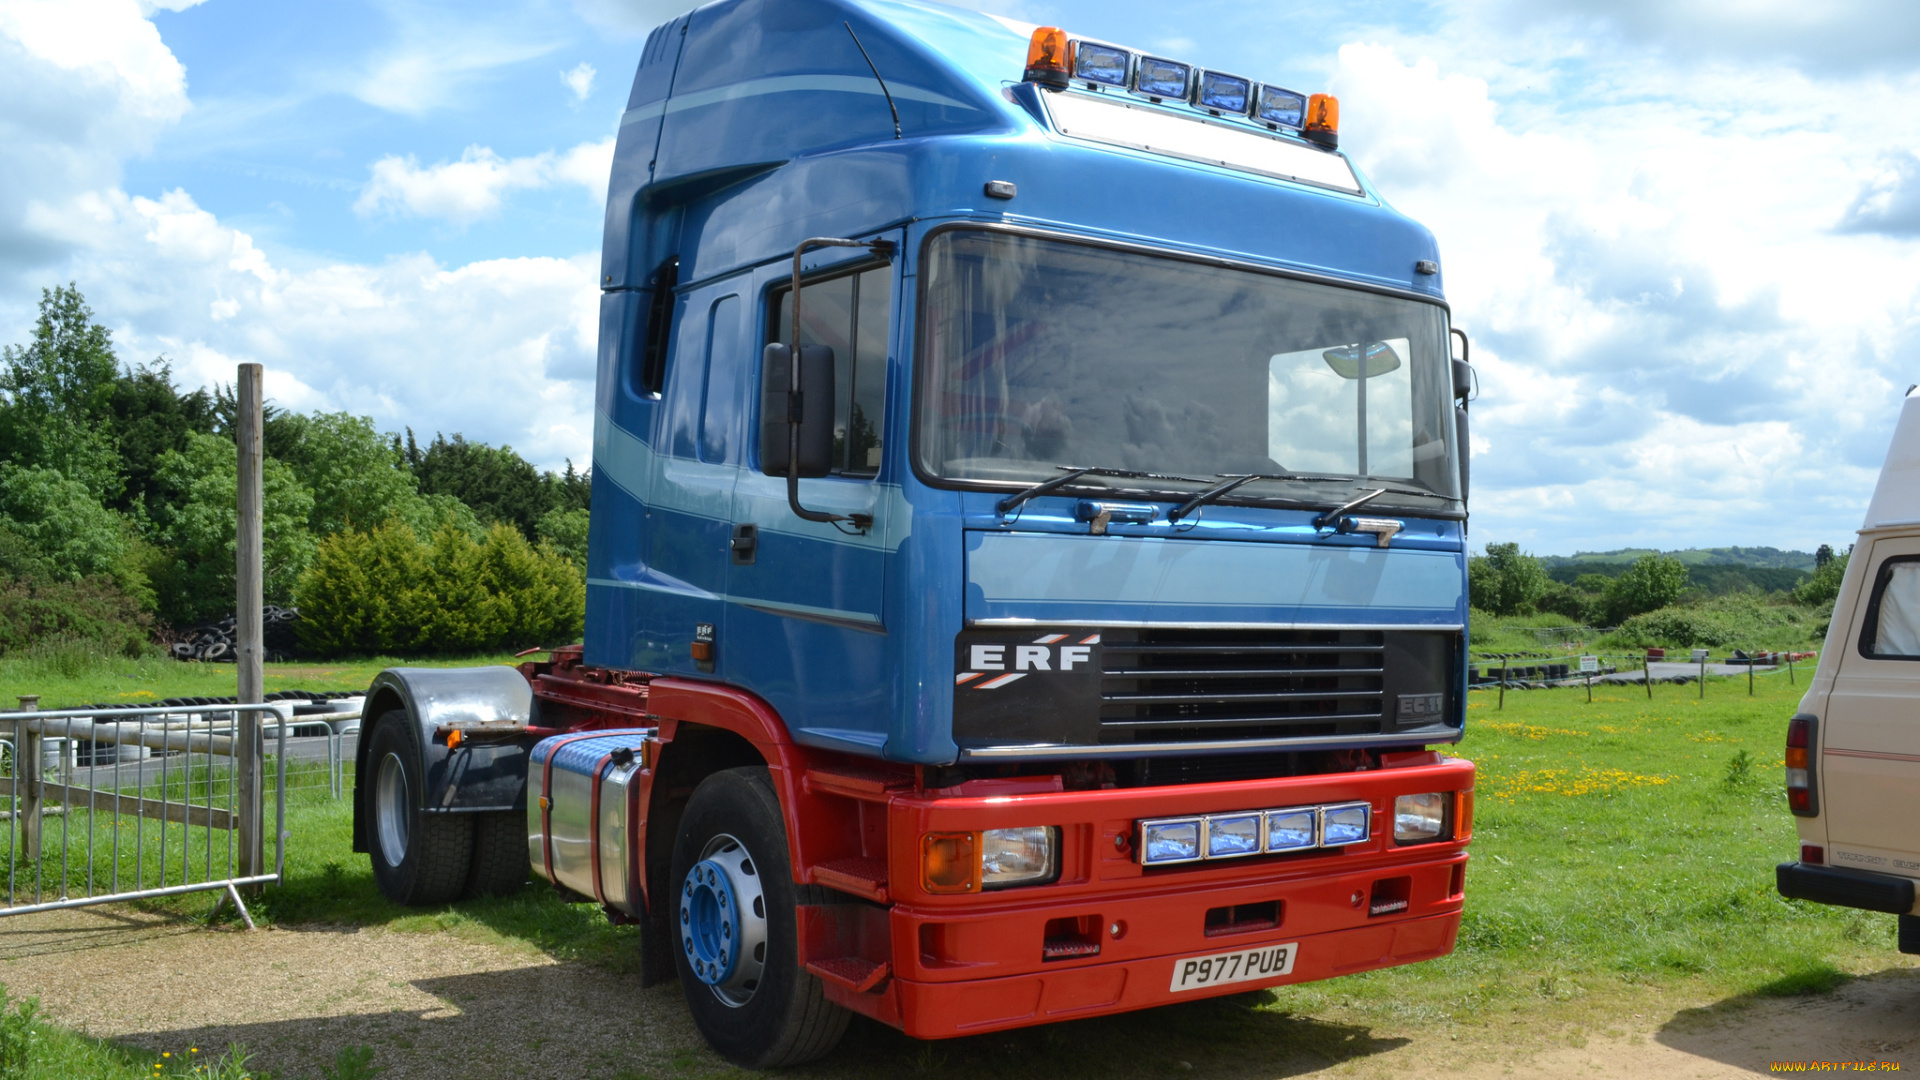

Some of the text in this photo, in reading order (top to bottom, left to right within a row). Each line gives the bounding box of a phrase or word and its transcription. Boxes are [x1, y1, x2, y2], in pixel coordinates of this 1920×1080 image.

[970, 644, 1091, 671] ERF
[1837, 851, 1887, 865] TRANSIT
[1181, 948, 1288, 985] P977 PUB
